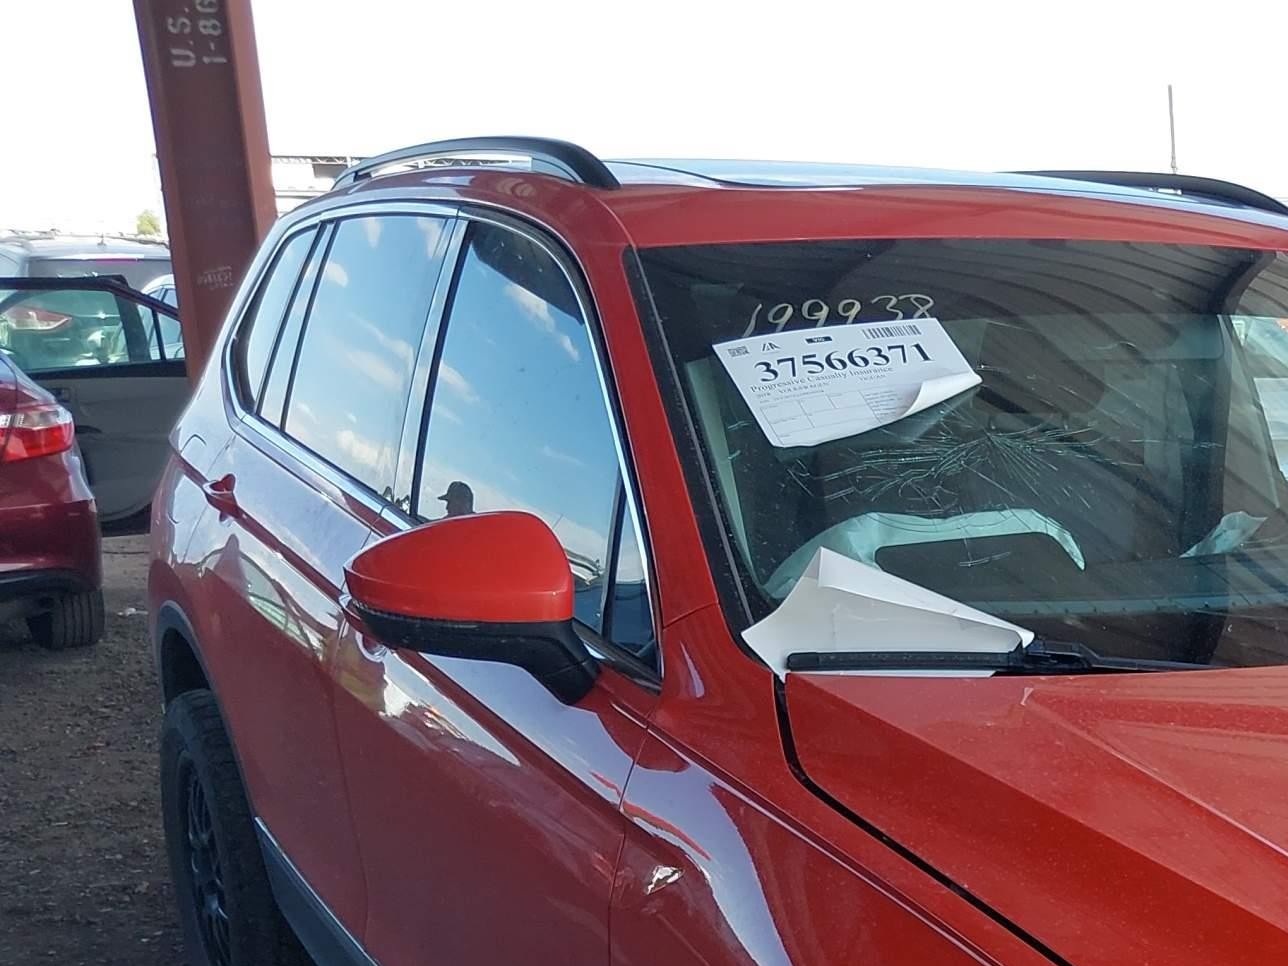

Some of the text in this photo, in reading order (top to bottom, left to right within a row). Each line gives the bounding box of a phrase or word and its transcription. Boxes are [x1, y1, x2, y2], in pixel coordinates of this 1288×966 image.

[754, 343, 934, 382] 37566371
[750, 366, 894, 393] Progressive Casualty Insurance
